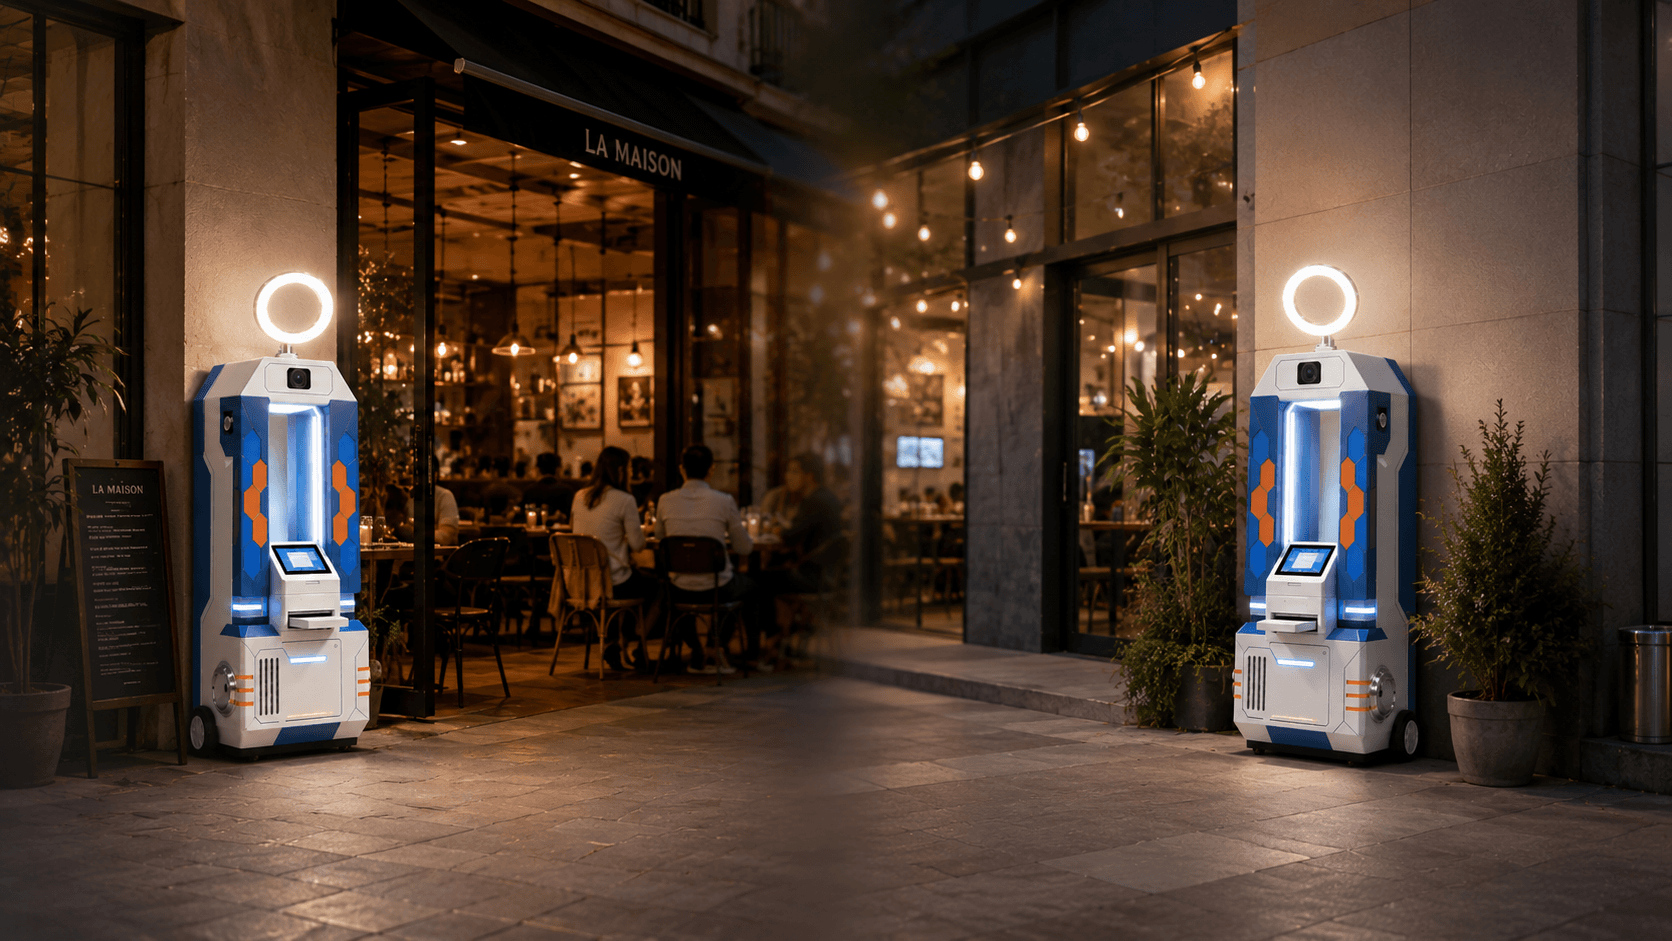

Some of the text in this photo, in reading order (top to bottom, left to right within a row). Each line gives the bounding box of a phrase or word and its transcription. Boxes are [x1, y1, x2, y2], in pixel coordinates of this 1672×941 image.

[585, 128, 682, 181] LA MAISON
[92, 484, 144, 495] LA MAISON
